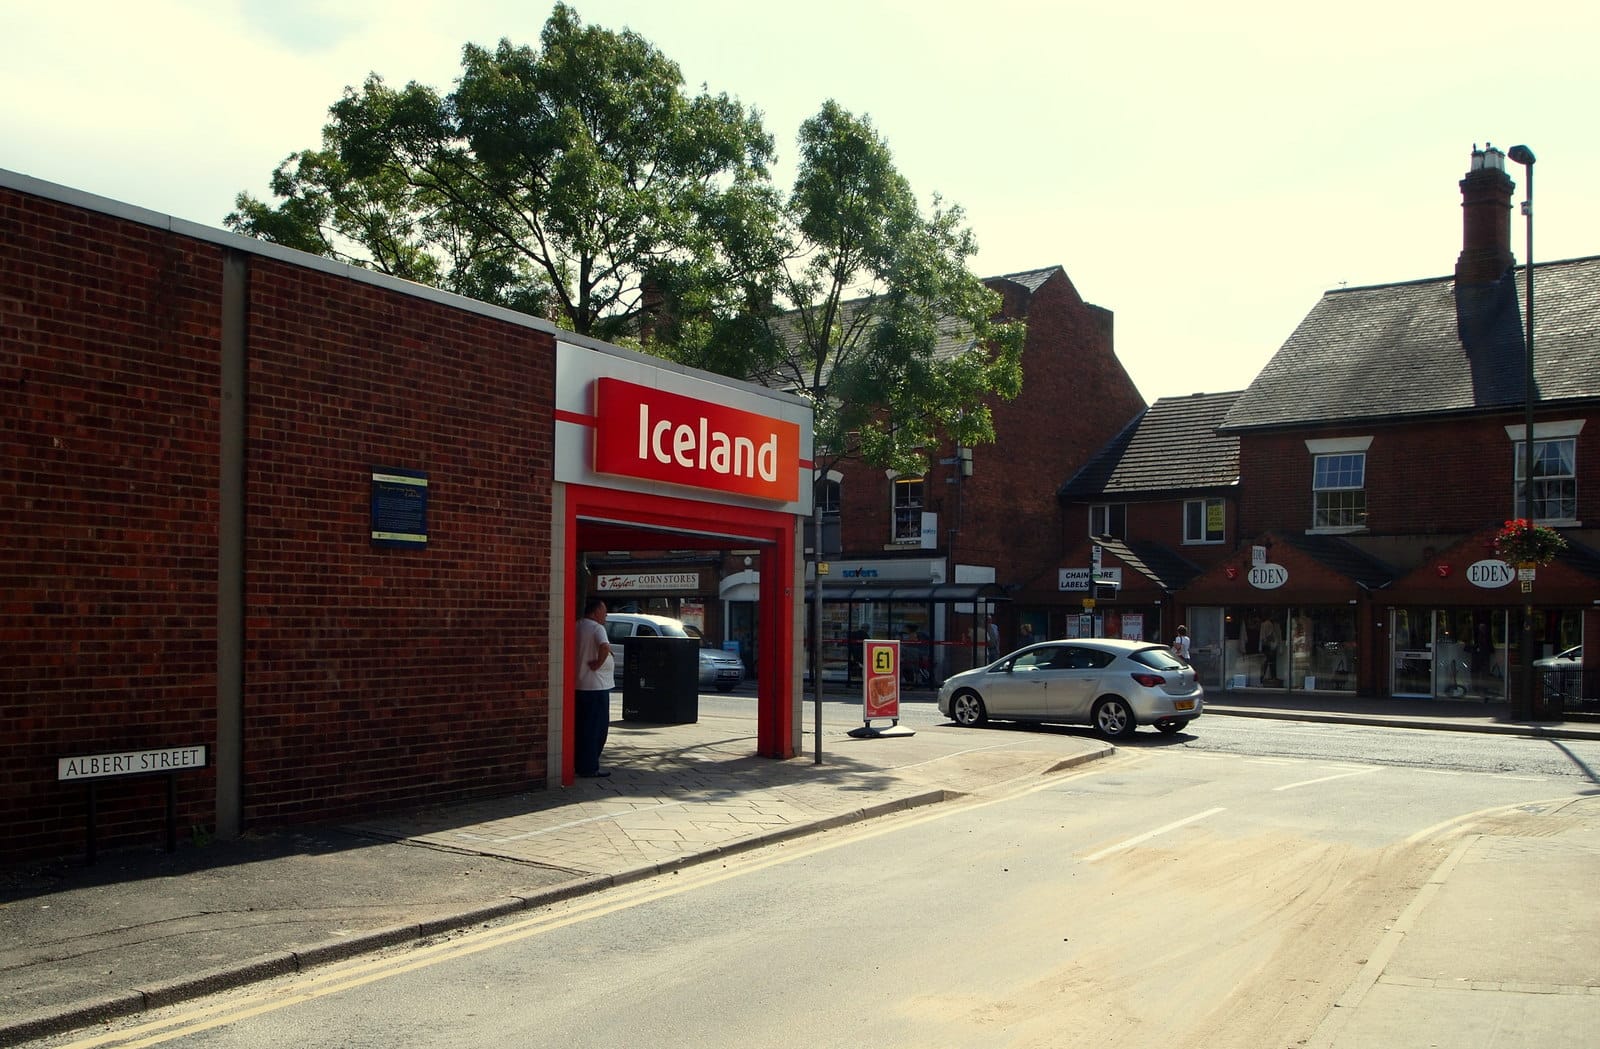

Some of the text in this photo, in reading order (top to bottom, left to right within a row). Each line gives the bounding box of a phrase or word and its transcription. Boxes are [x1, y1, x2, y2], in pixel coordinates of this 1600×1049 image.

[639, 403, 777, 482] Iceland
[638, 574, 697, 584] CORN STORES
[1065, 571, 1089, 579] CHAIN
[1252, 568, 1284, 584] EDEN
[1471, 565, 1510, 582] EDEN
[876, 652, 890, 669] £1
[66, 750, 199, 776] ALBERT STREET
